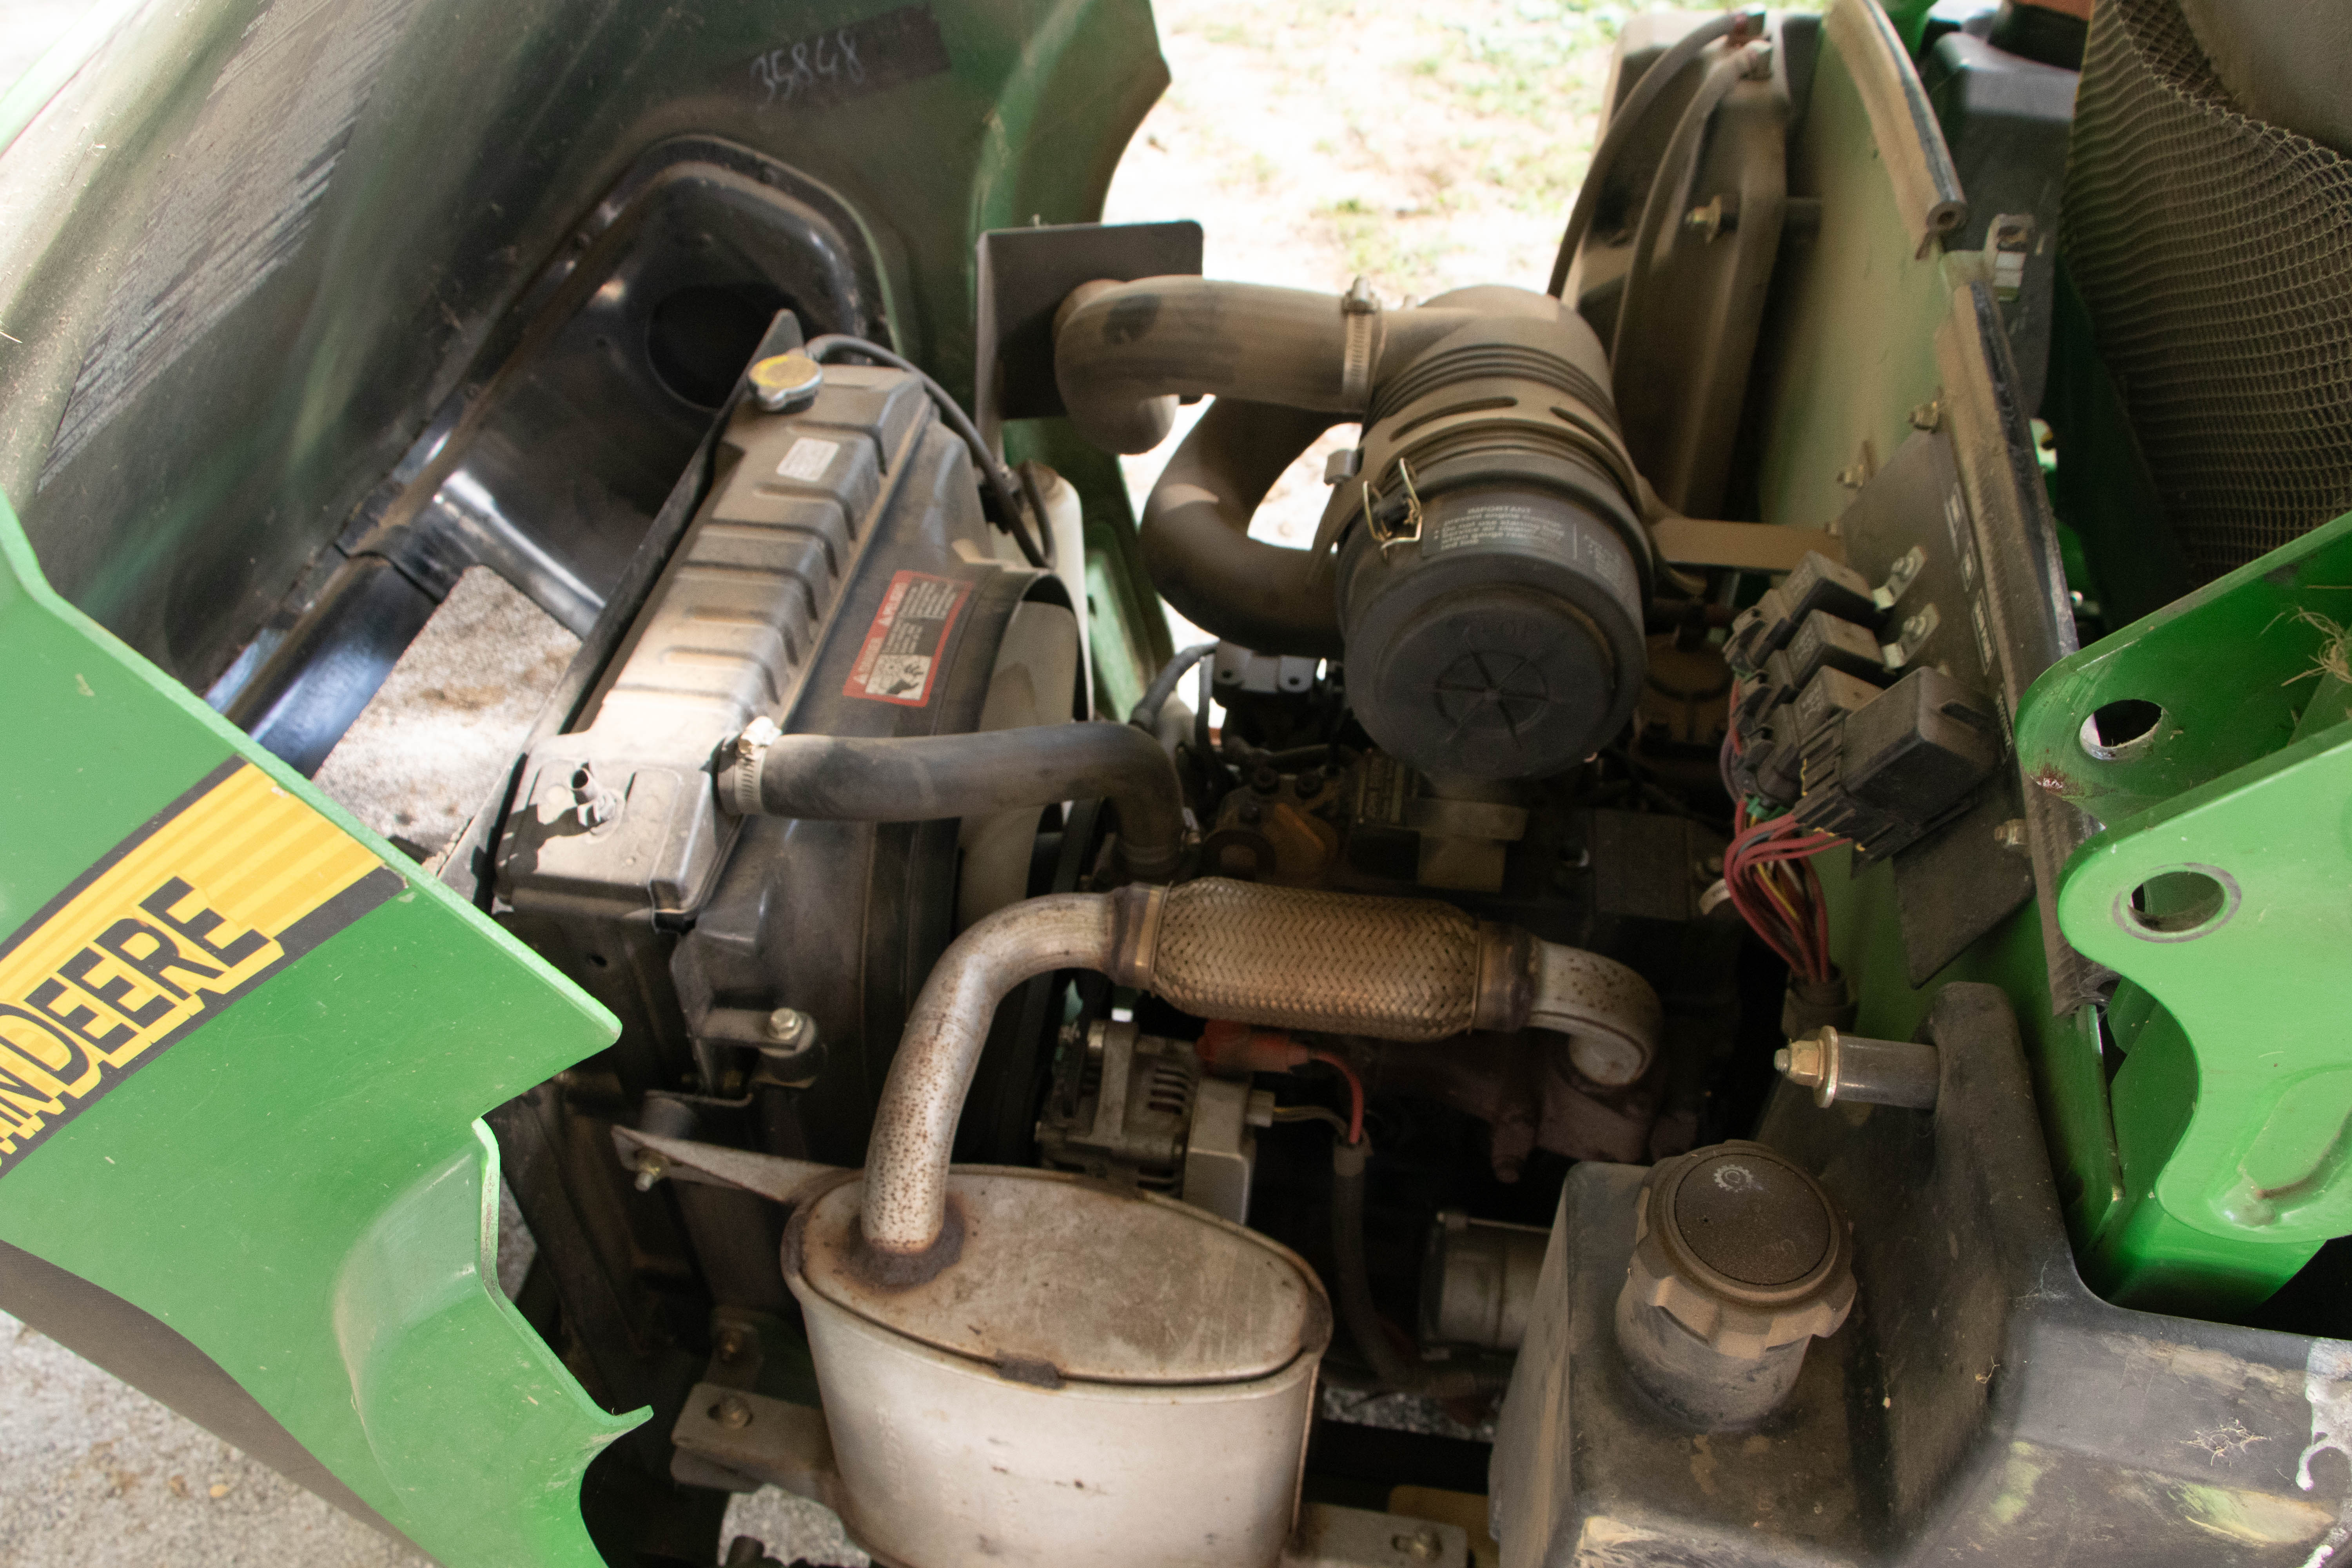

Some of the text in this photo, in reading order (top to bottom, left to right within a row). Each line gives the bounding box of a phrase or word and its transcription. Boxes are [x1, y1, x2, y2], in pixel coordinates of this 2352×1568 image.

[750, 30, 865, 110] 35848
[1468, 505, 1531, 515] IMPORTANT
[0, 876, 271, 1087] DEERE
